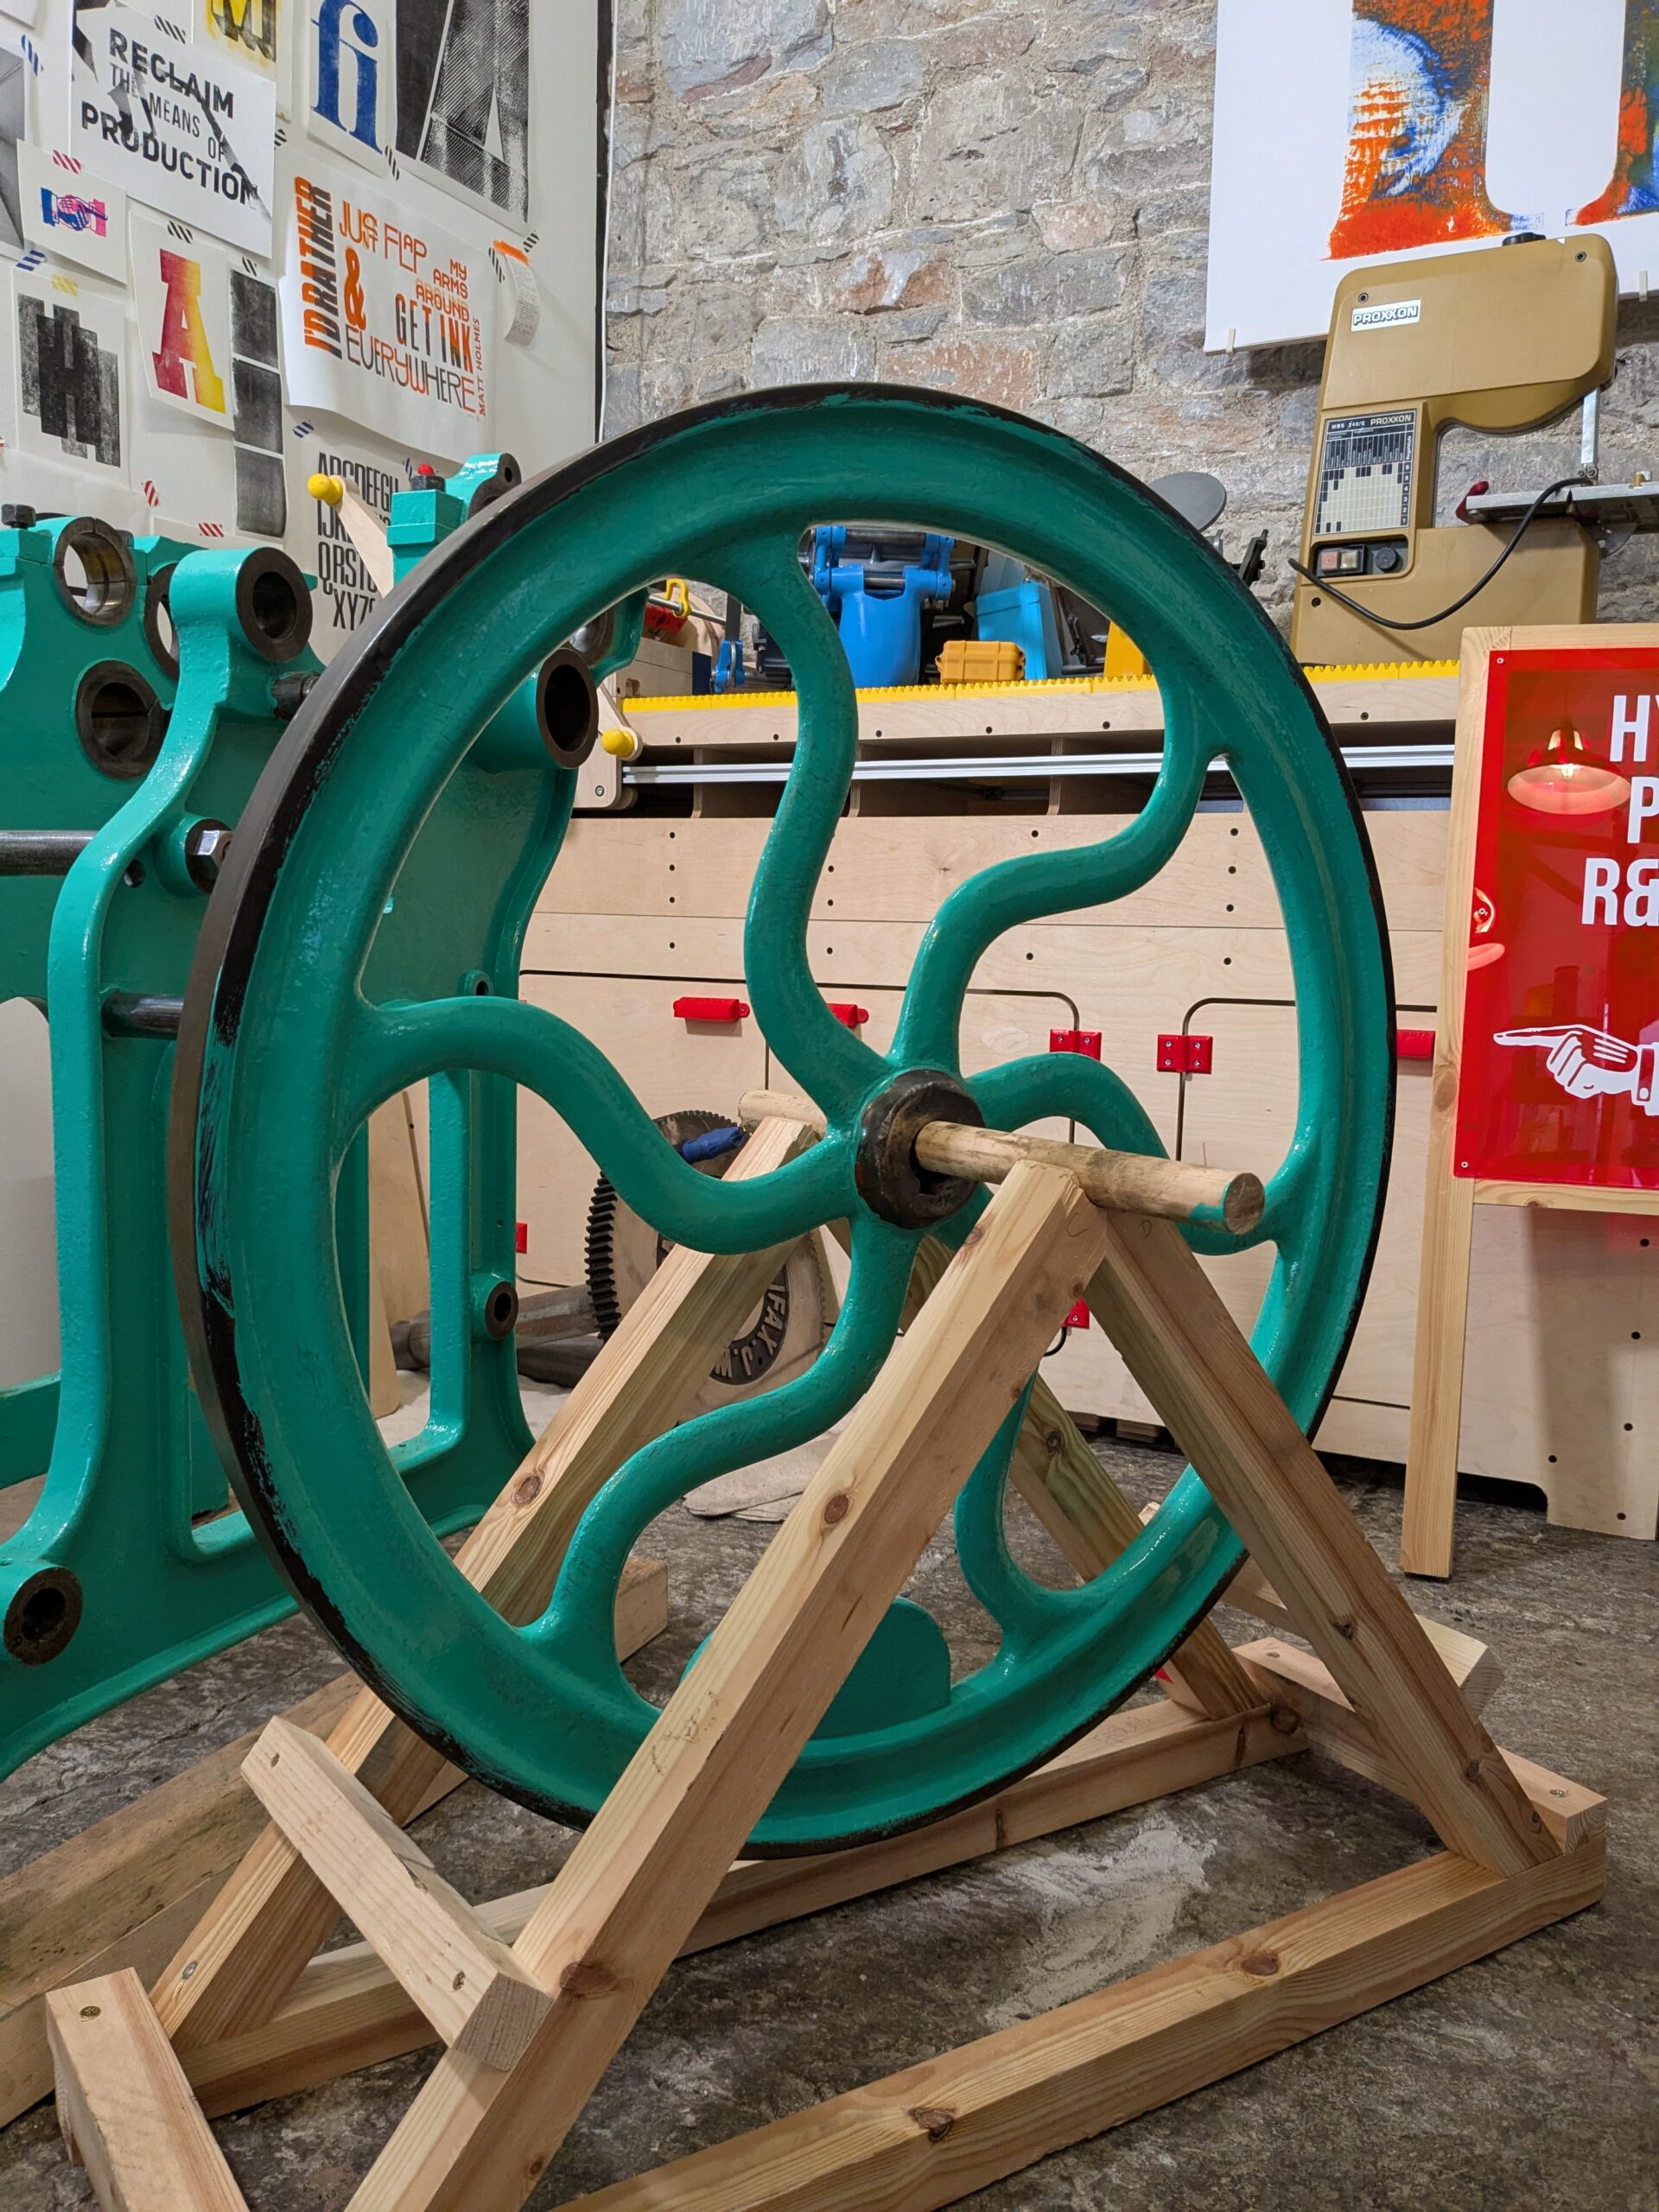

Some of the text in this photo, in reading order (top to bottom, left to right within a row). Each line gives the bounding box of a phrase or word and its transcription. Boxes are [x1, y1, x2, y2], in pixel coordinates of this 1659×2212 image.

[110, 27, 234, 119] RECLAIM
[110, 62, 139, 99] THE
[149, 92, 200, 138] MEANS
[81, 100, 257, 206] PRODUCTION
[294, 175, 339, 317] RATHER
[340, 200, 427, 274] JUST FLAP
[449, 258, 467, 282] MY
[344, 245, 366, 332] &
[416, 281, 470, 323] AROUND
[433, 268, 468, 300] ARMS
[1353, 306, 1419, 326] PROXXON
[152, 249, 226, 415] A
[395, 293, 474, 373] GET INK
[473, 317, 486, 417] MATT HOLMES
[1370, 415, 1412, 427] PROXXON
